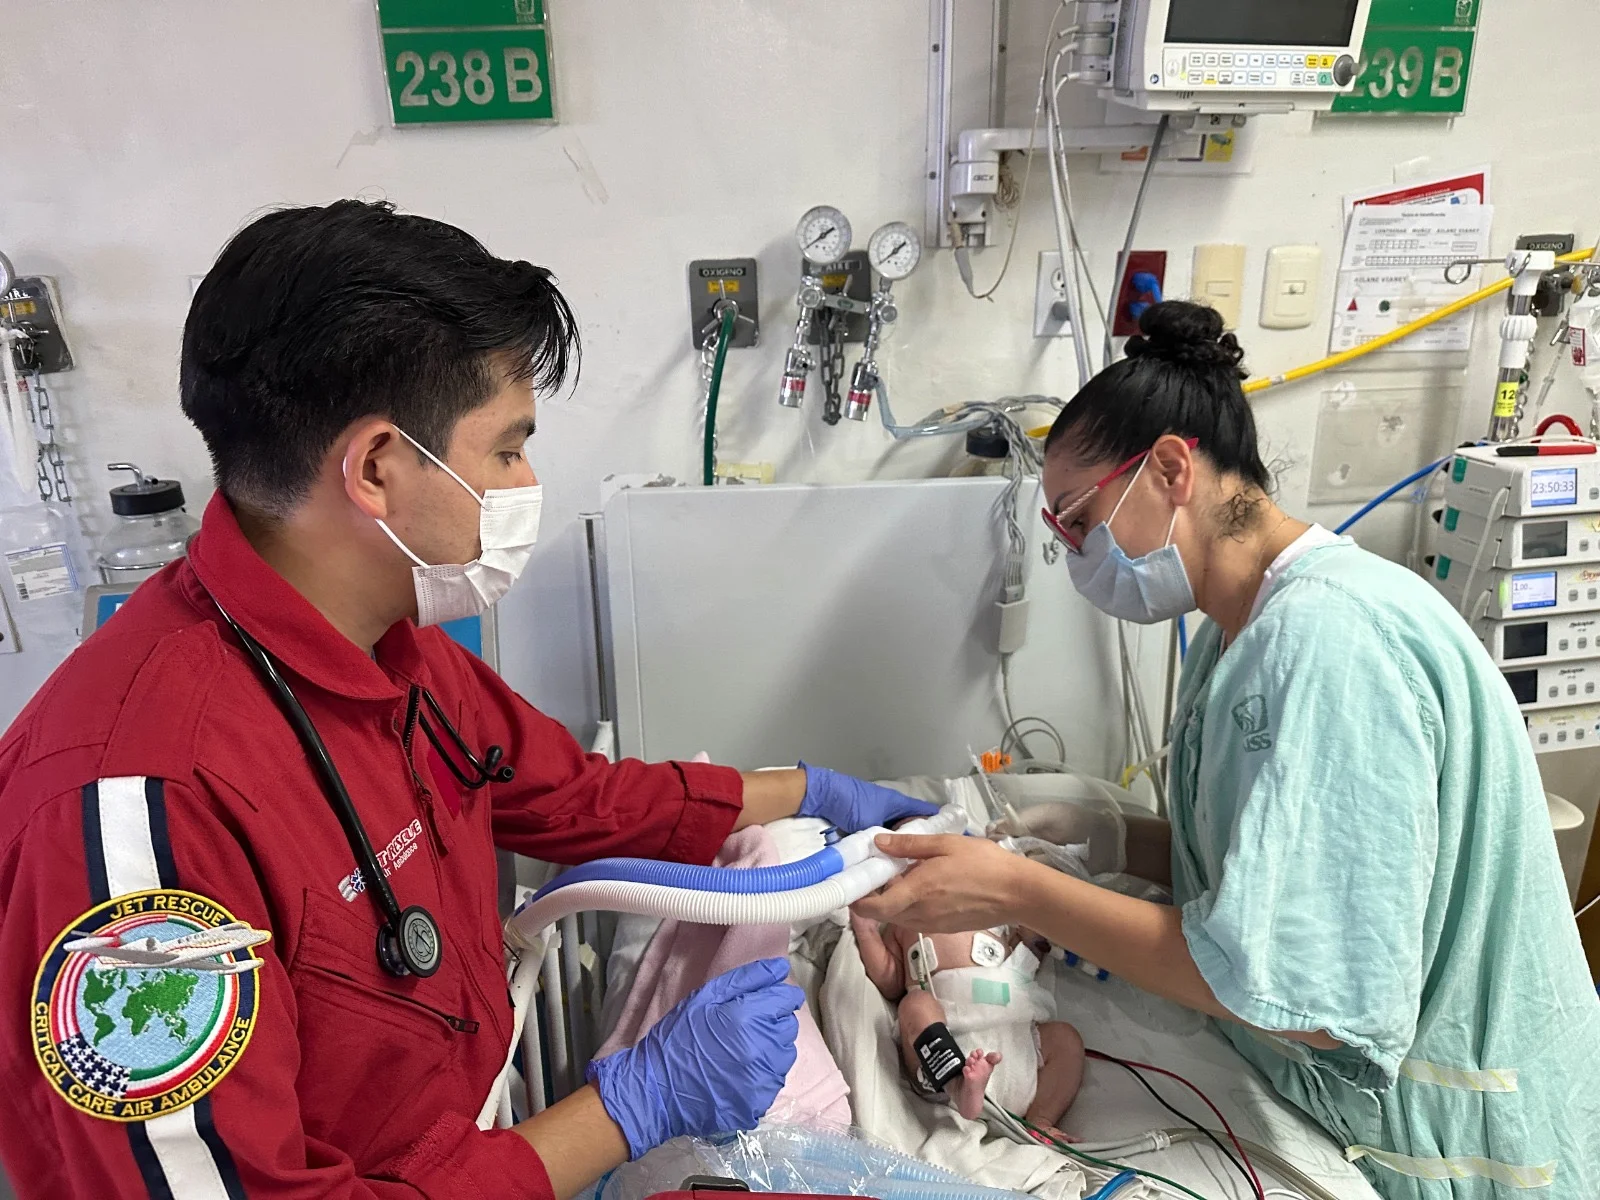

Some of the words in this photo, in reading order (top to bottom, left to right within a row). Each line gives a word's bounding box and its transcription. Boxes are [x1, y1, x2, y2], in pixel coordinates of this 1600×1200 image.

[396, 49, 495, 107] 238
[503, 47, 543, 103] B
[1430, 46, 1463, 97] B
[702, 268, 744, 277] OXIGENO
[1501, 389, 1516, 400] 12
[1532, 480, 1575, 494] 23:50:33
[386, 818, 423, 861] RESCUE
[110, 896, 147, 920] JET
[153, 895, 227, 927] RESCUE
[35, 1001, 68, 1085] CRITICAL
[68, 1084, 117, 1114] CARE
[121, 1099, 155, 1117] AIR
[160, 1017, 250, 1110] AMBULANCE
